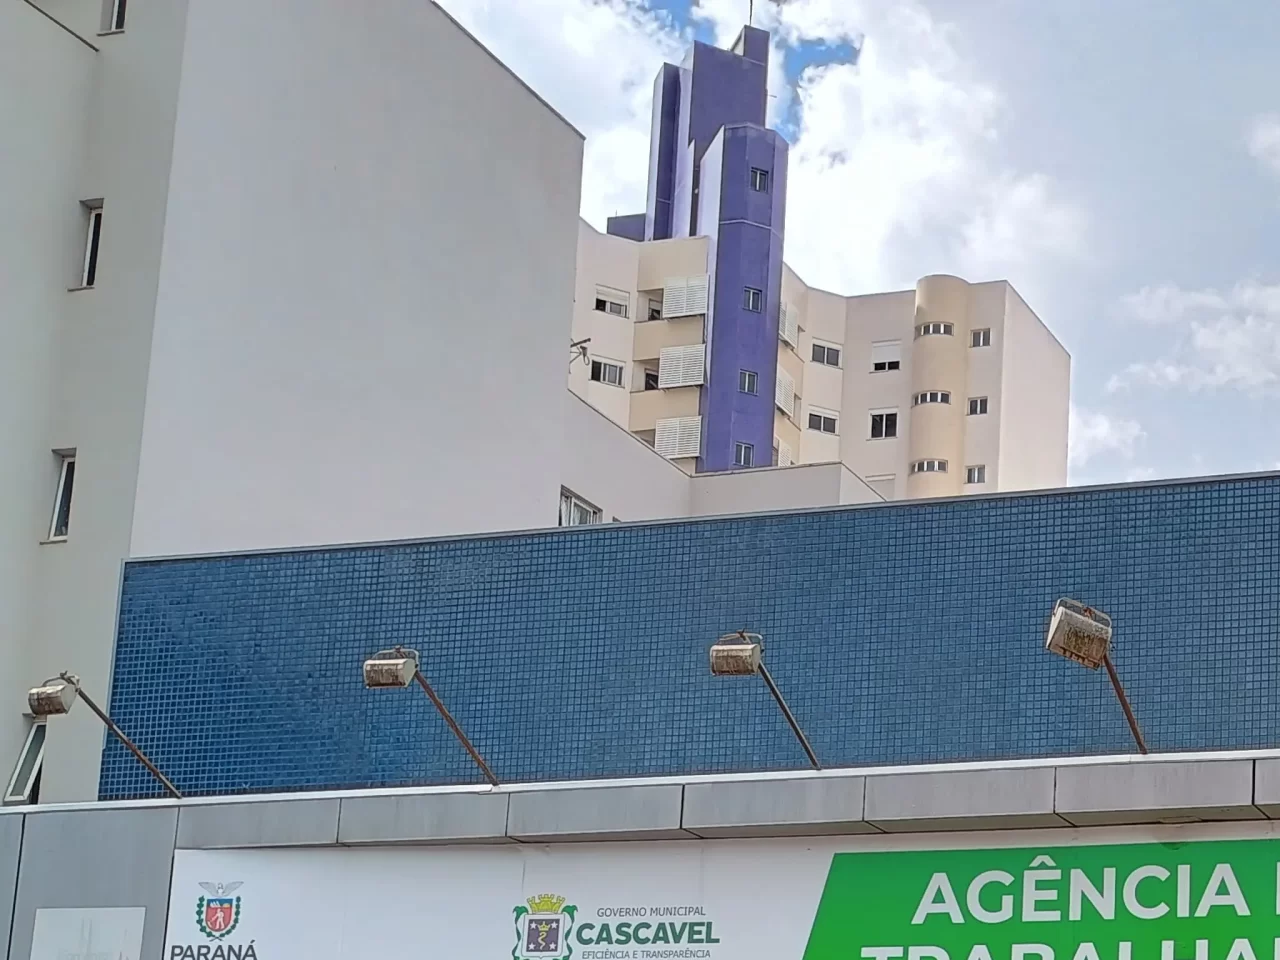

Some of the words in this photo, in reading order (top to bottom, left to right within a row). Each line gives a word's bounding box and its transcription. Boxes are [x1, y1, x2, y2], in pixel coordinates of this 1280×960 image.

[910, 854, 1252, 926] AGÊNCIA
[596, 907, 647, 918] GOVERNO
[650, 906, 707, 917] MUNICIPAL
[575, 921, 720, 946] CASCAVEL
[581, 948, 630, 960] EFICIÊNCIA
[632, 950, 638, 960] E
[641, 947, 711, 959] TRANSPARÊNCIA
